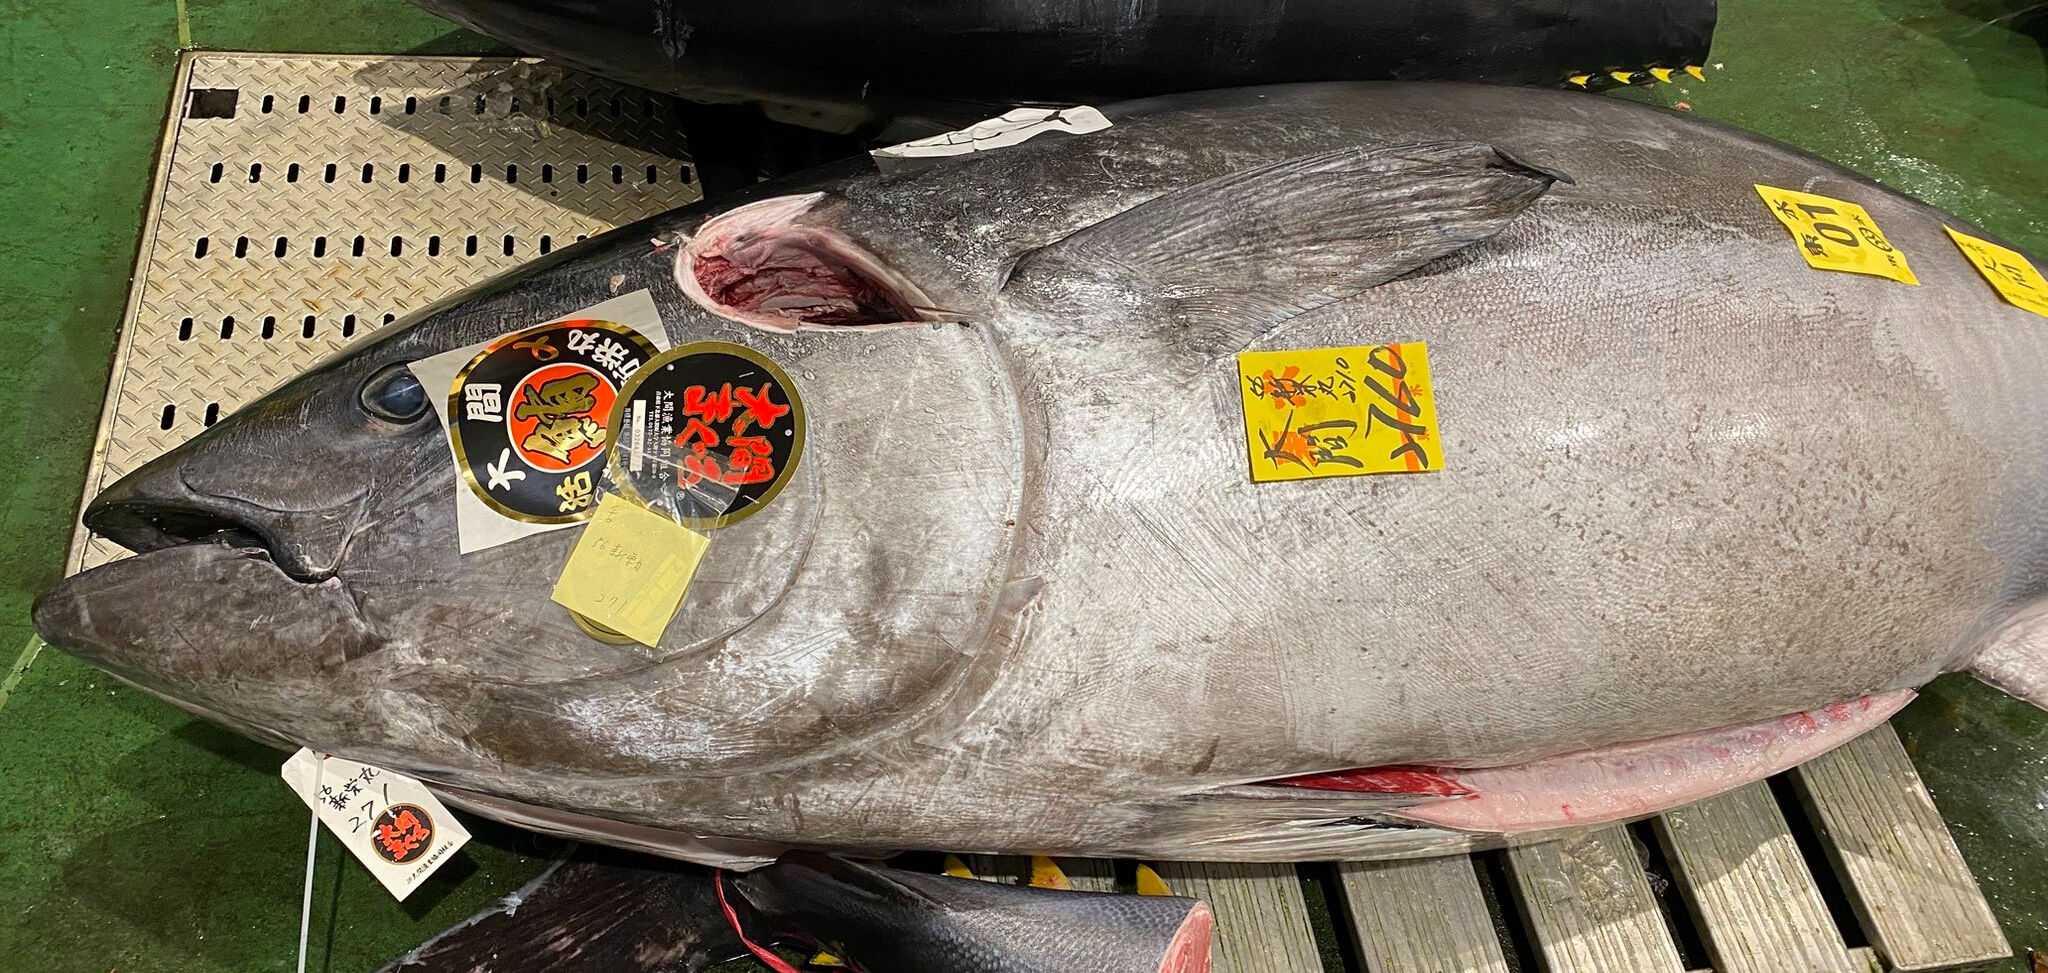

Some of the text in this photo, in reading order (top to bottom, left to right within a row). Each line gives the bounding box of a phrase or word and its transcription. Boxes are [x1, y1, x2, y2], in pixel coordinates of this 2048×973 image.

[1795, 203, 1860, 248] 01
[513, 371, 607, 465] 鮪
[721, 382, 790, 486] 大間
[1258, 409, 1364, 475] 大間
[348, 783, 389, 833] 271
